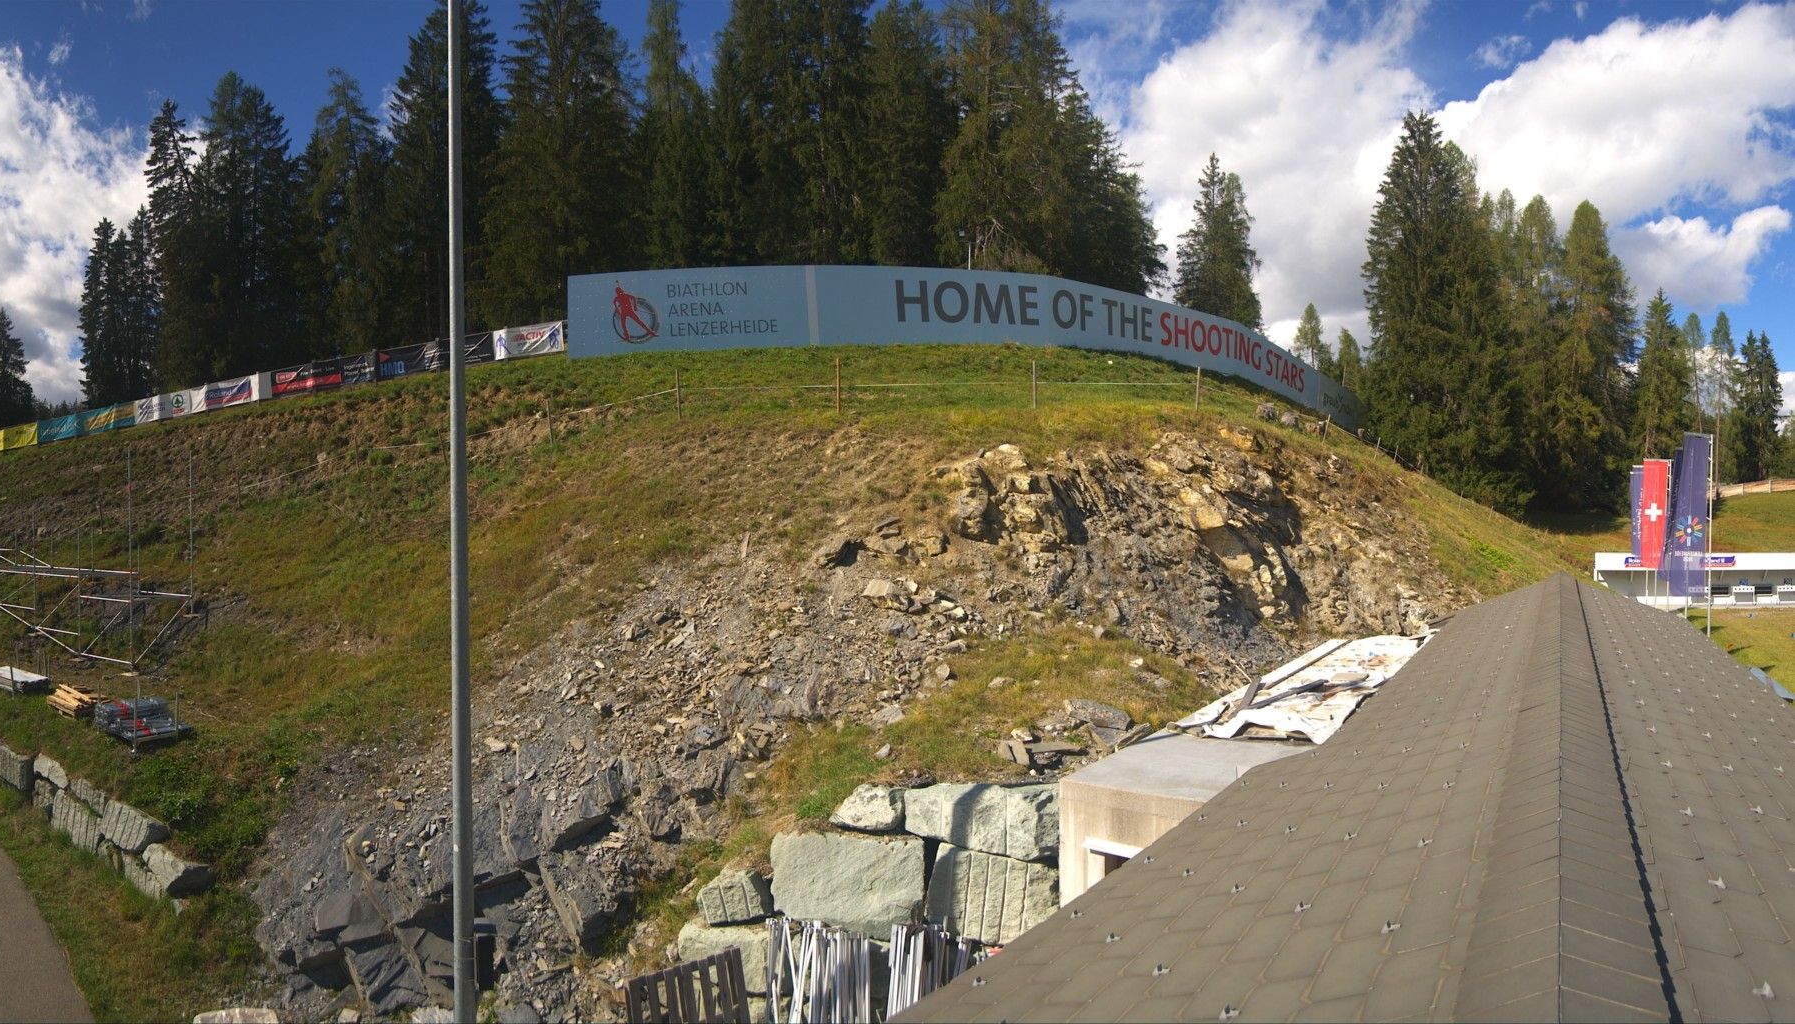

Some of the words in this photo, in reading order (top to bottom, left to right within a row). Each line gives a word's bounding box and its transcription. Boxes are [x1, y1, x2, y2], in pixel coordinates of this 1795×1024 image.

[667, 281, 748, 298] BIATHLON
[668, 302, 723, 317] ARENA
[670, 319, 778, 337] LENZERHEIDE
[895, 280, 1039, 325] HOME
[1052, 290, 1093, 331] OF
[1102, 298, 1153, 342] THE
[1160, 312, 1262, 370] SHOOTING
[1266, 350, 1304, 393] STARS
